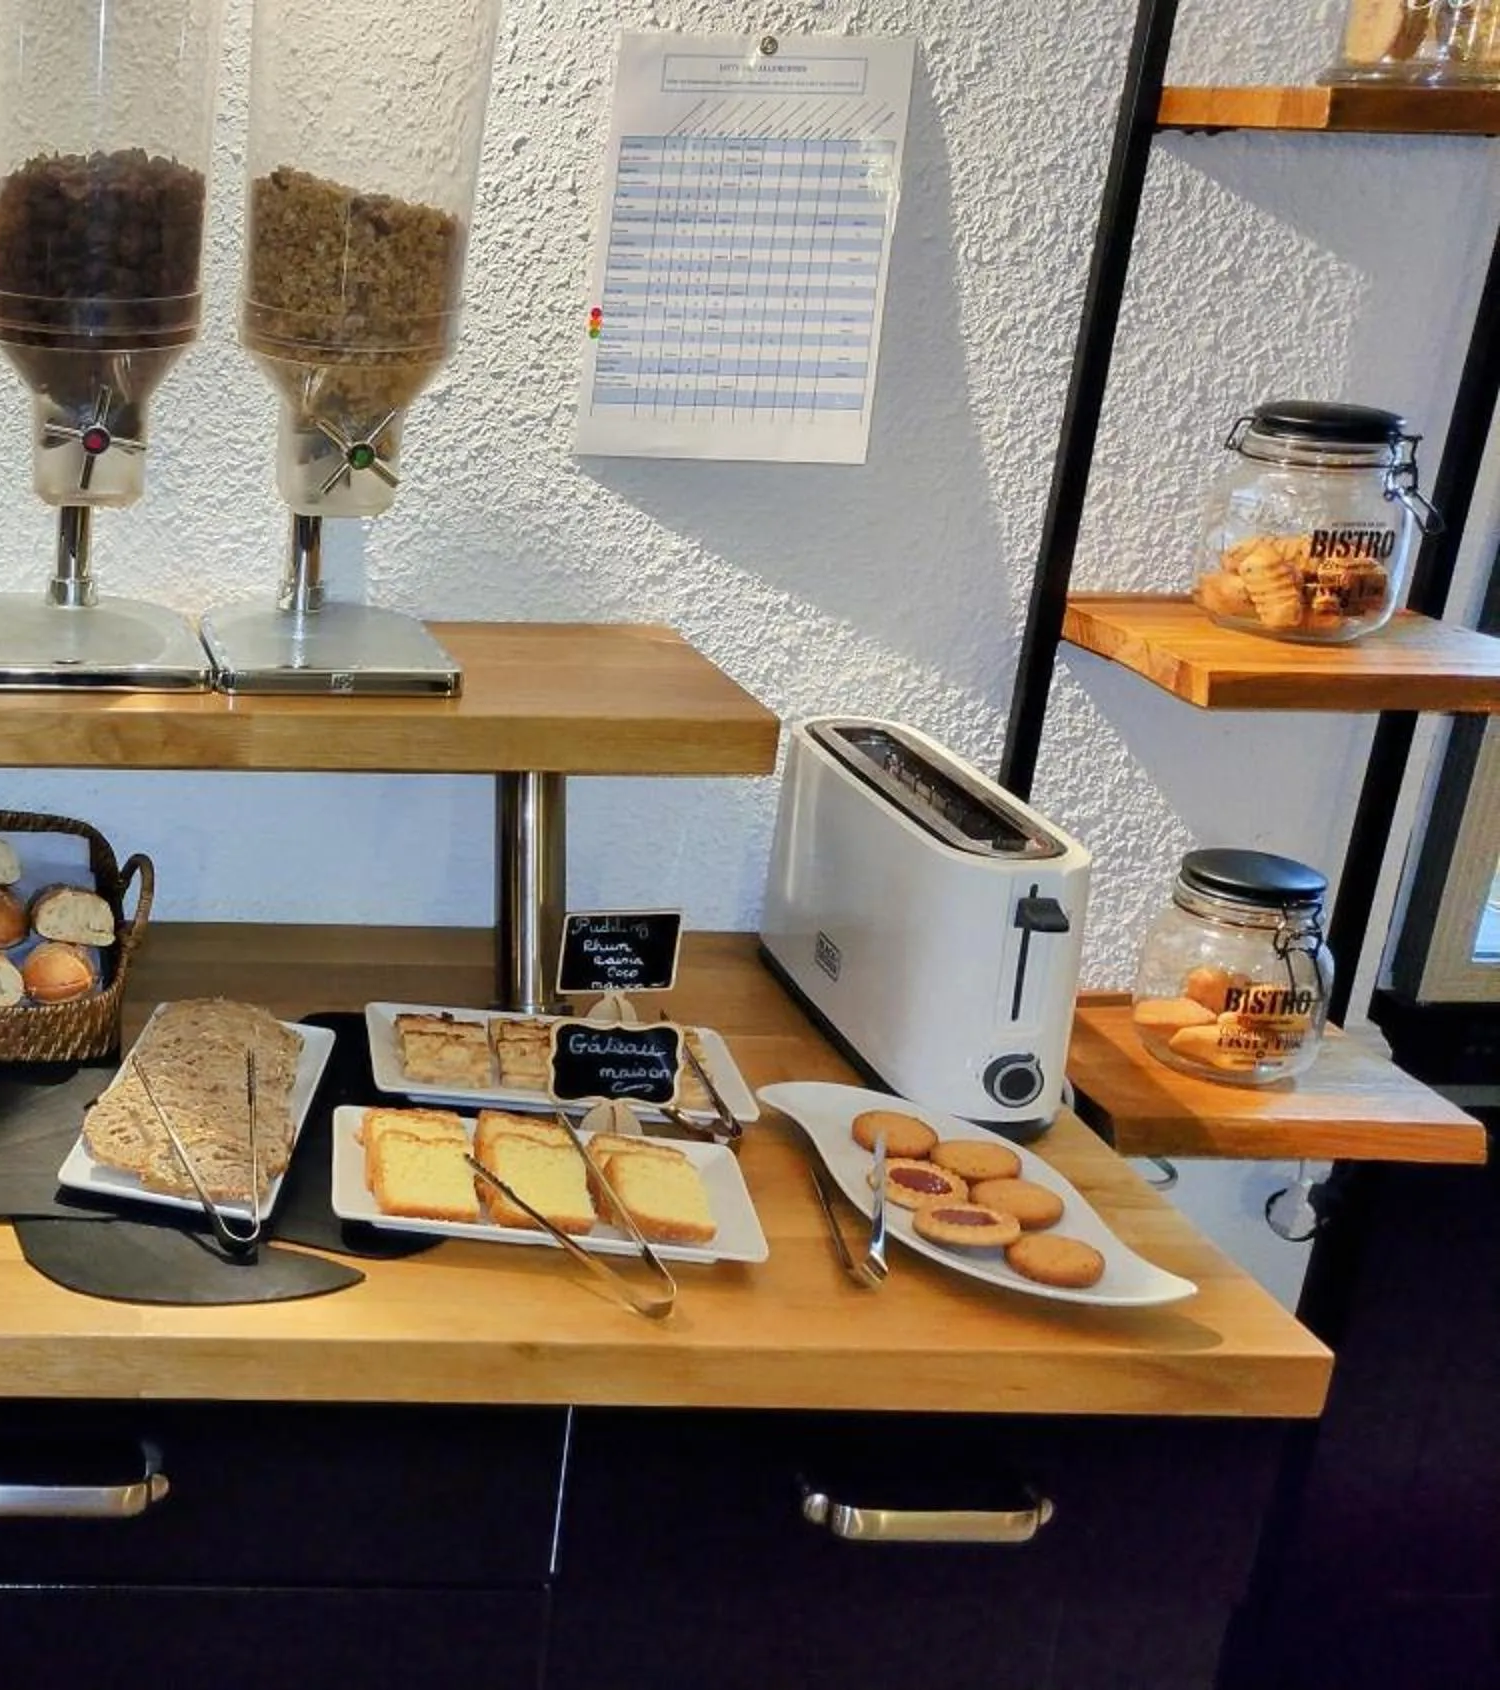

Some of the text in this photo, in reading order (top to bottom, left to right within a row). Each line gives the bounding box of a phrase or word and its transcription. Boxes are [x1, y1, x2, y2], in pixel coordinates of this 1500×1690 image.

[1309, 528, 1395, 559] BISTRO
[1223, 987, 1312, 1015] BISTRO
[599, 1061, 671, 1079] maison
